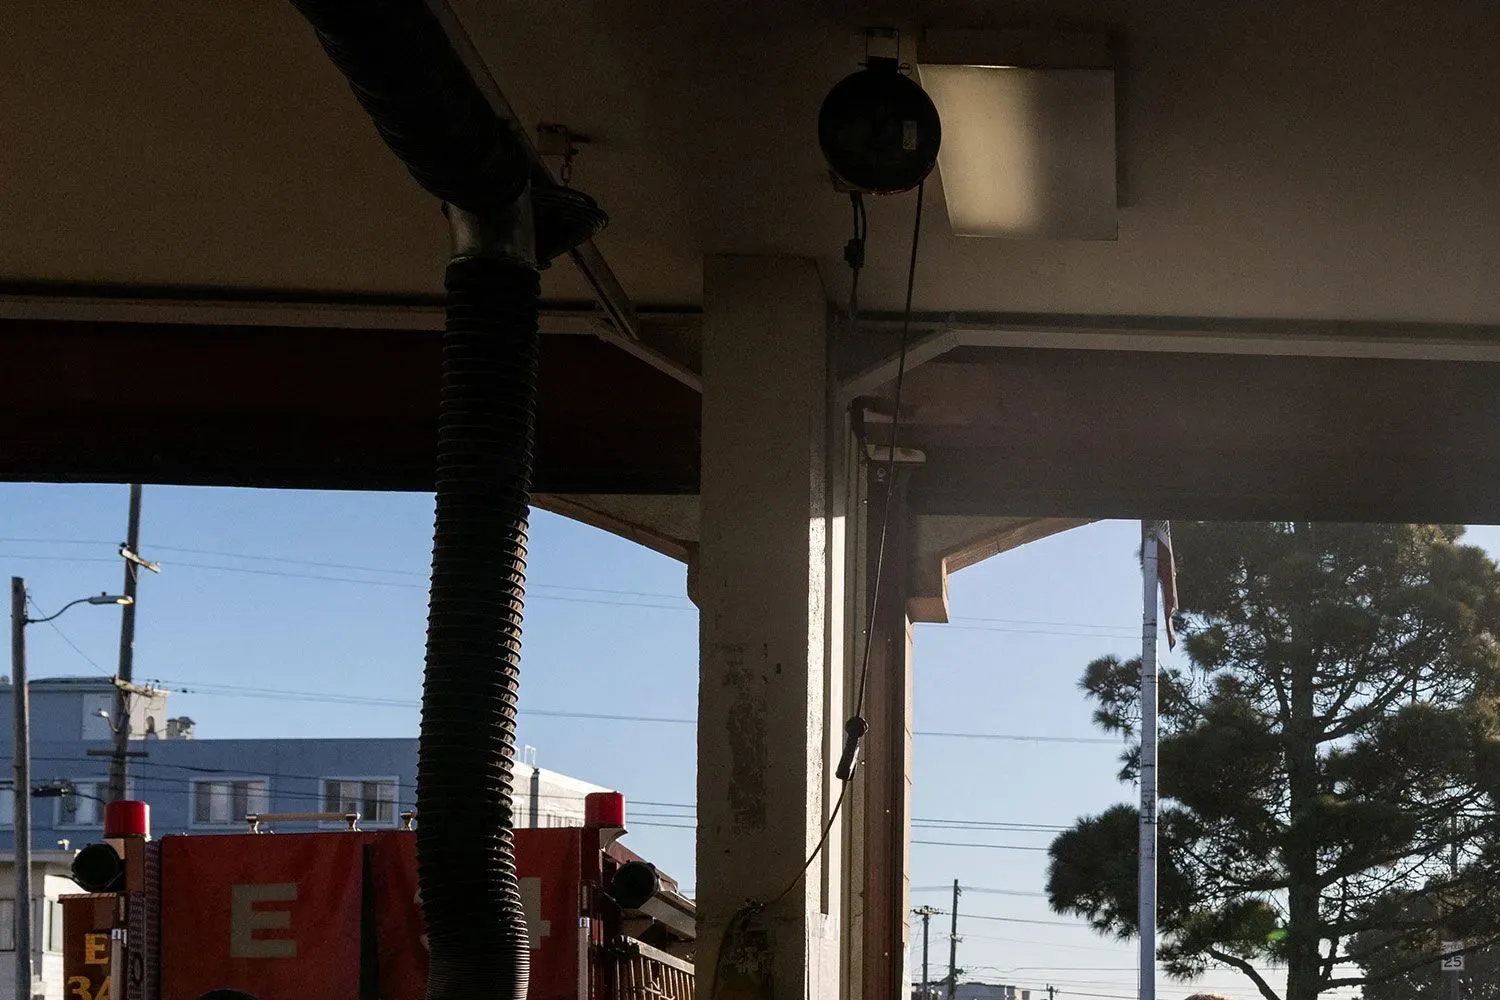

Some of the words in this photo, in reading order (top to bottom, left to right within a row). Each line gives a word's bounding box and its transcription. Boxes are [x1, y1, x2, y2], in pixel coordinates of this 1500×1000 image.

[230, 882, 298, 959] E
[84, 933, 110, 965] E
[1444, 956, 1462, 968] 25
